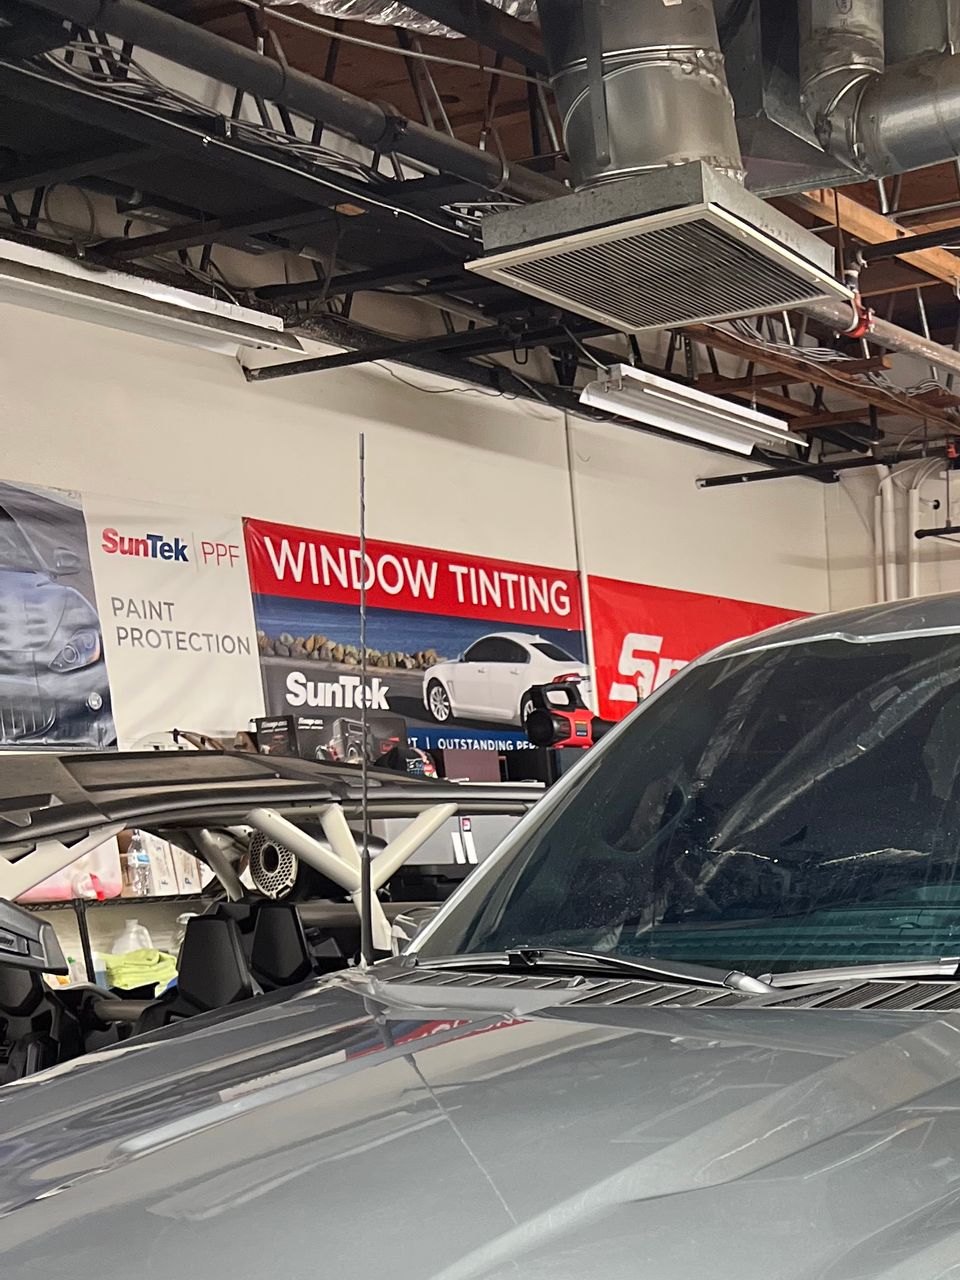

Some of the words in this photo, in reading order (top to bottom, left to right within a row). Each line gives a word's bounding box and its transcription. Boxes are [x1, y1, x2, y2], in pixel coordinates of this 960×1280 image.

[101, 527, 190, 562] SunTek
[201, 540, 241, 569] PPF
[263, 536, 439, 600] WINDOW
[448, 564, 572, 617] TINTING
[111, 596, 175, 622] PAINT
[116, 626, 251, 656] PROTECTION
[285, 671, 390, 710] SunTek
[437, 738, 514, 751] OUTSTANDING
